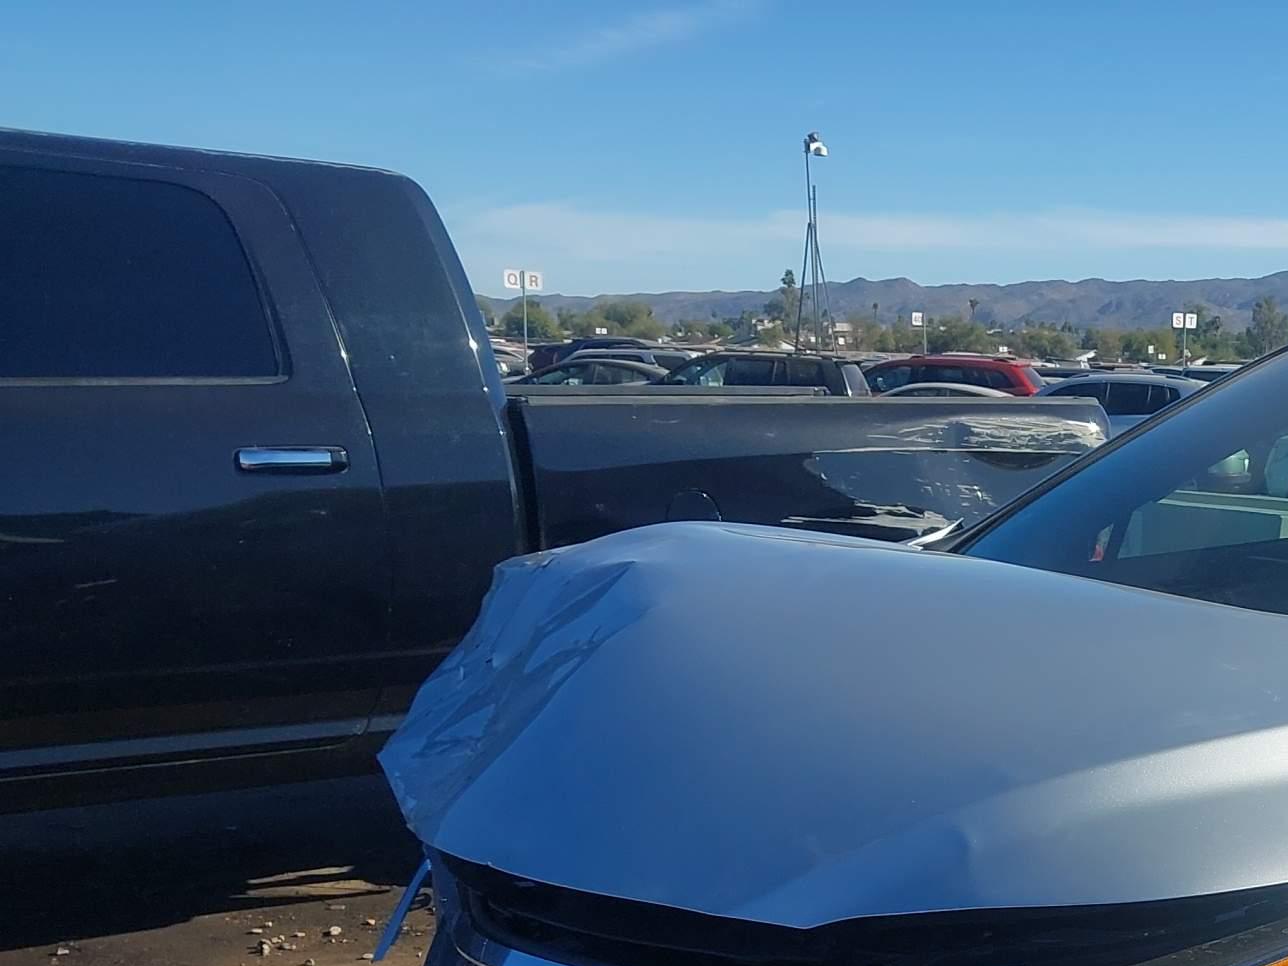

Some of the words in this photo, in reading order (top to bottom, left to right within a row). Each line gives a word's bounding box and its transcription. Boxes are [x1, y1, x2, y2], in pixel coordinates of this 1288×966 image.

[507, 272, 519, 286] Q
[529, 274, 538, 288] R
[1175, 316, 1183, 326] S
[1188, 316, 1195, 326] T
